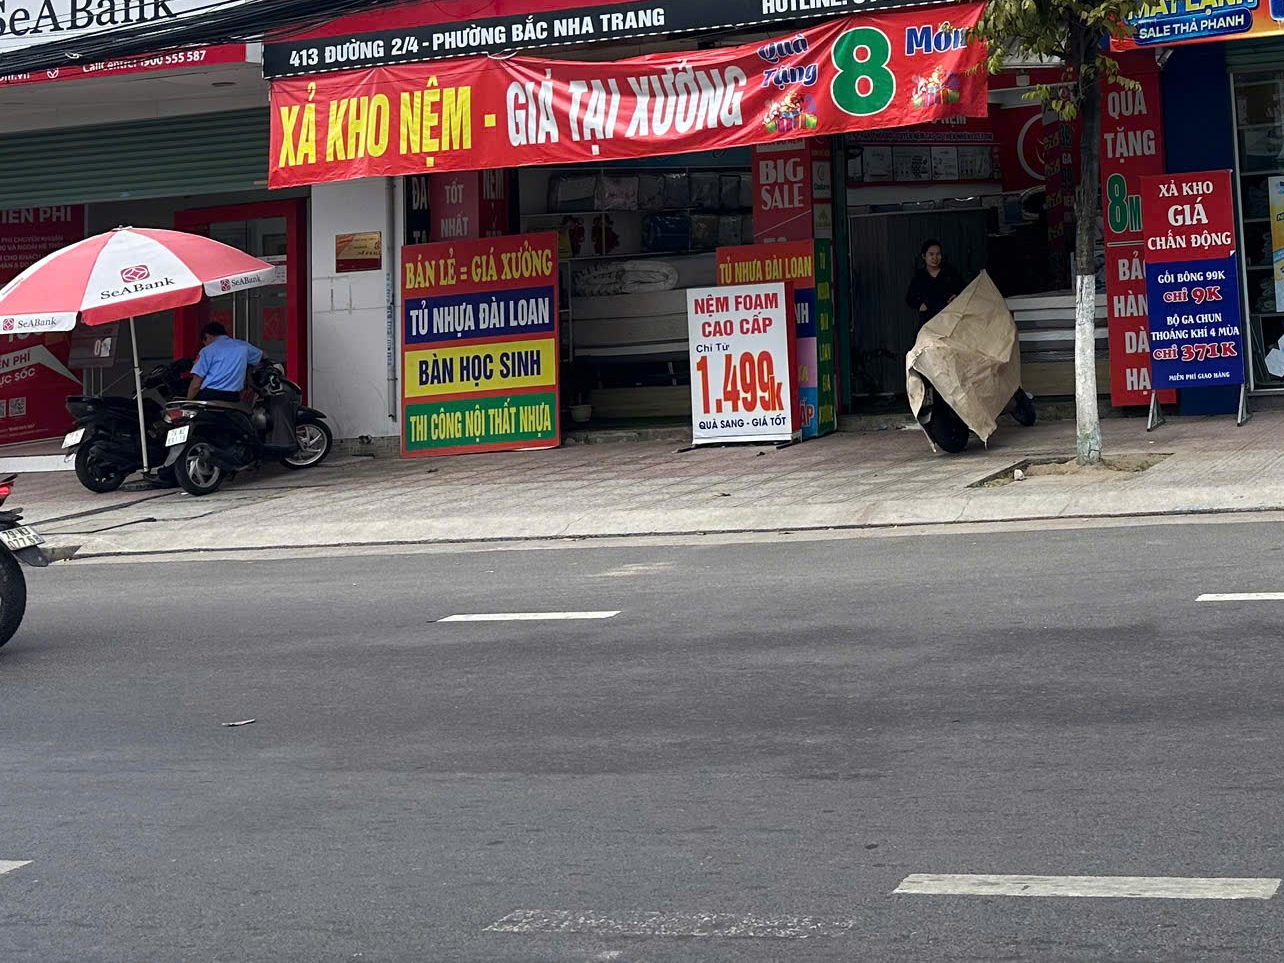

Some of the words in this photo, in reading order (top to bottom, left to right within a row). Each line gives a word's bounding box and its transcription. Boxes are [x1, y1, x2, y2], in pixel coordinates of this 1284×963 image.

[1139, 25, 1171, 39] SALE
[1172, 17, 1198, 34] THẢ
[1200, 14, 1245, 31] PHANH
[830, 26, 897, 117] 8
[278, 81, 317, 168] XẢ
[325, 93, 390, 162] KHO
[400, 76, 472, 168] NỆM
[505, 68, 559, 147] GIÁ
[568, 76, 620, 156] TẠI
[625, 59, 747, 138] XƯỞNG
[758, 157, 804, 185] BIG
[760, 184, 805, 211] SALE
[1158, 179, 1179, 198] XẢ
[1182, 180, 1213, 195] KHO
[1167, 197, 1209, 227] GIÁ
[1147, 229, 1188, 251] CHẤN
[1191, 230, 1232, 250] ĐỘNG
[230, 273, 262, 287] SeABank
[1157, 269, 1175, 284] GỐI
[1177, 269, 1204, 283] BÔNG
[1206, 270, 1226, 281] 99K
[100, 276, 175, 300] SeABank
[694, 294, 730, 316] NỆM
[735, 292, 779, 312] FOAM
[17, 315, 57, 329] SeABank
[701, 319, 734, 338] CAO
[740, 312, 773, 335] CẤP
[1166, 313, 1180, 326] BỘ
[1182, 315, 1194, 325] GA
[1196, 312, 1222, 324] CHUN
[1151, 328, 1189, 341] THOÁNG
[1190, 326, 1208, 339] KHÍ
[1209, 327, 1217, 338] 4
[1218, 324, 1240, 337] MÙA
[717, 341, 730, 352] Từ
[1153, 344, 1179, 360] CHỈ
[1181, 341, 1238, 362] 371K
[418, 353, 454, 386] BÀN
[460, 353, 494, 387] HỌC
[500, 350, 541, 378] SINH
[1198, 371, 1212, 380] GIAO
[1213, 370, 1230, 380] HÀNG
[699, 417, 718, 430] QUÀ
[720, 416, 744, 429] SANG
[751, 414, 769, 427] GIÁ
[770, 413, 786, 427] TỐT
